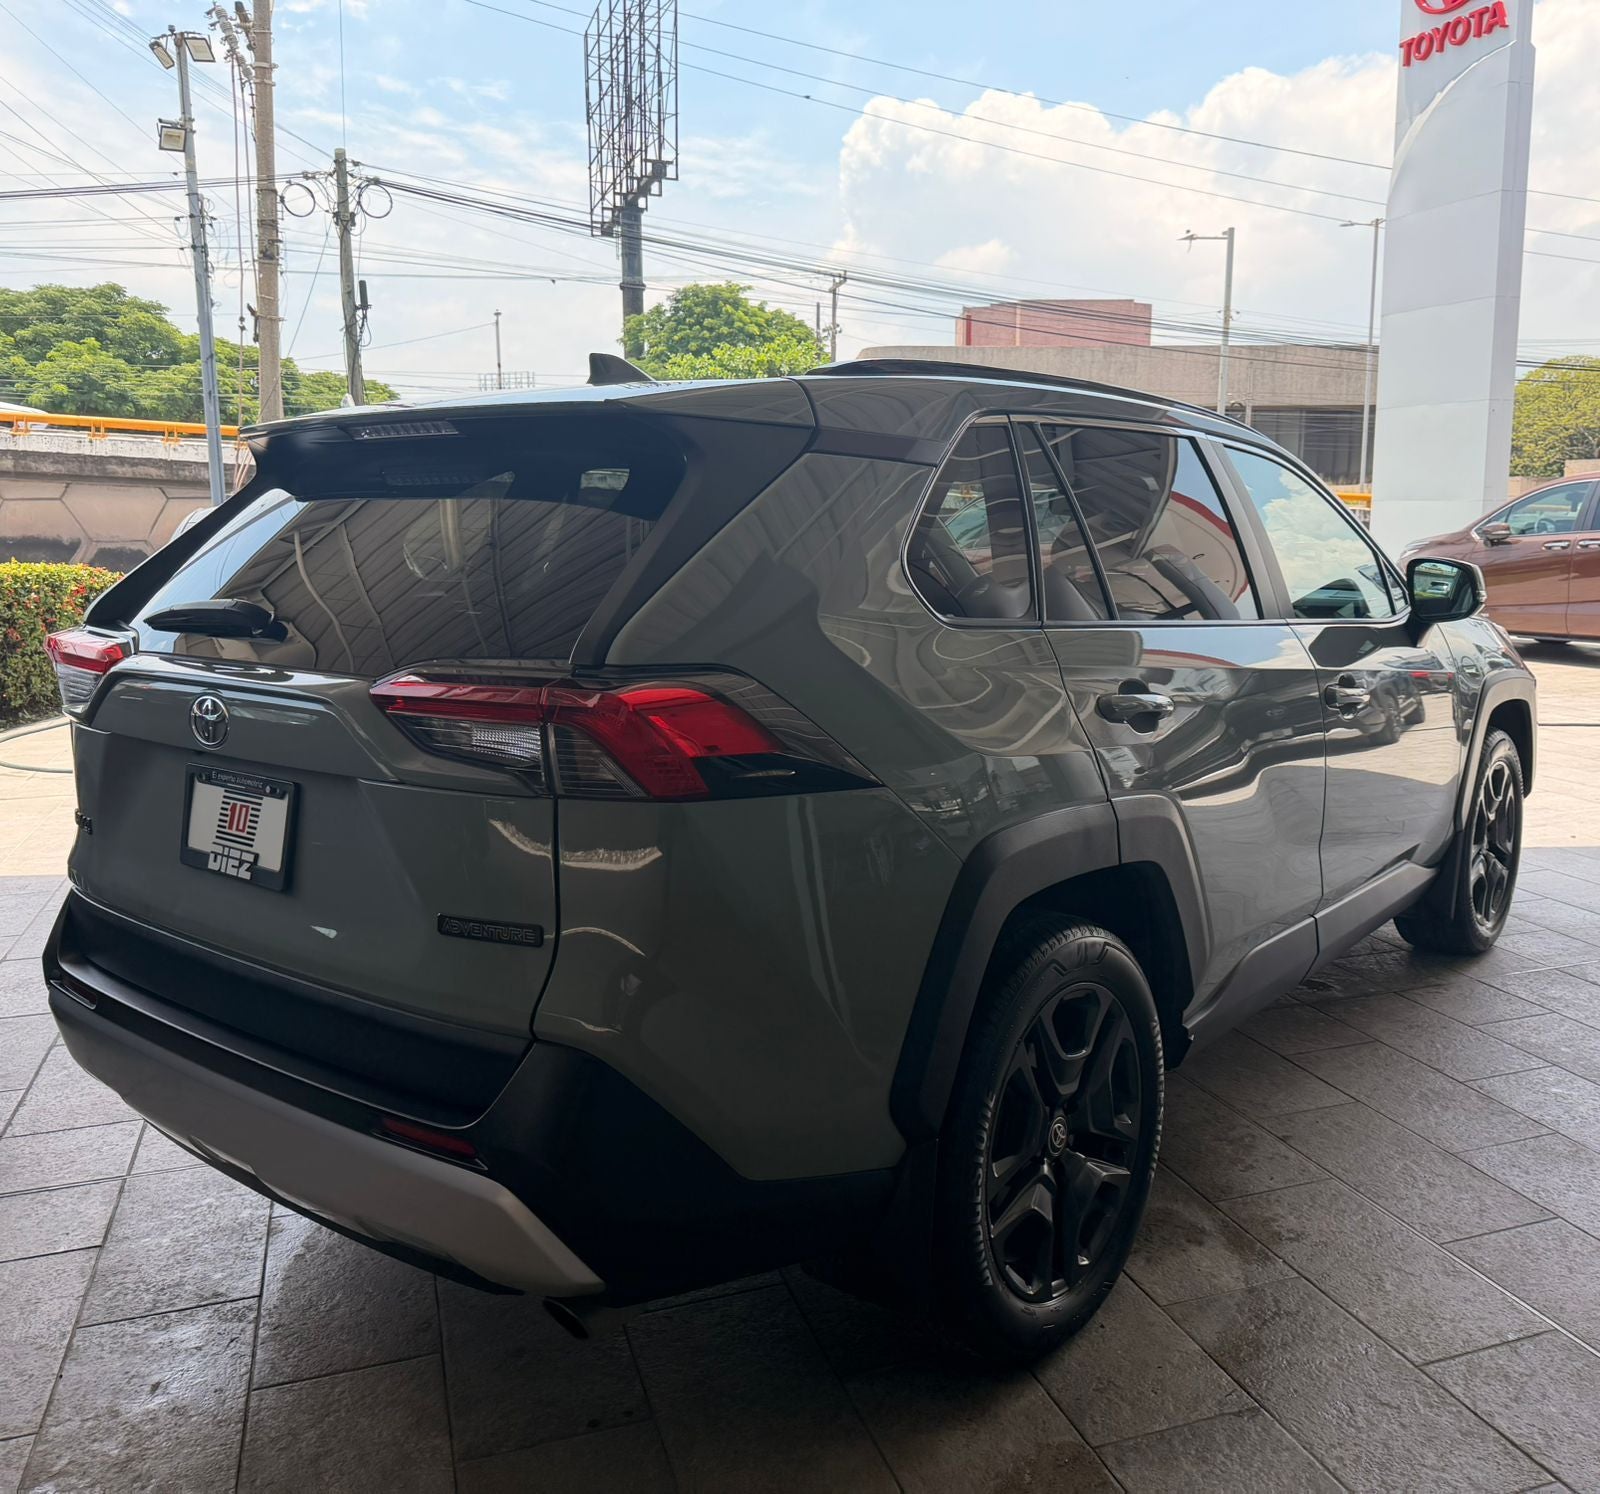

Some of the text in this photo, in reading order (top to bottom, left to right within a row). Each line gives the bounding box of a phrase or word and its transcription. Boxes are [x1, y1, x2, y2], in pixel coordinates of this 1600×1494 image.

[1399, 1, 1509, 67] TOYOTA
[228, 802, 250, 833] 10
[207, 845, 255, 880] DIEZ
[442, 917, 536, 943] ADVENTURE
